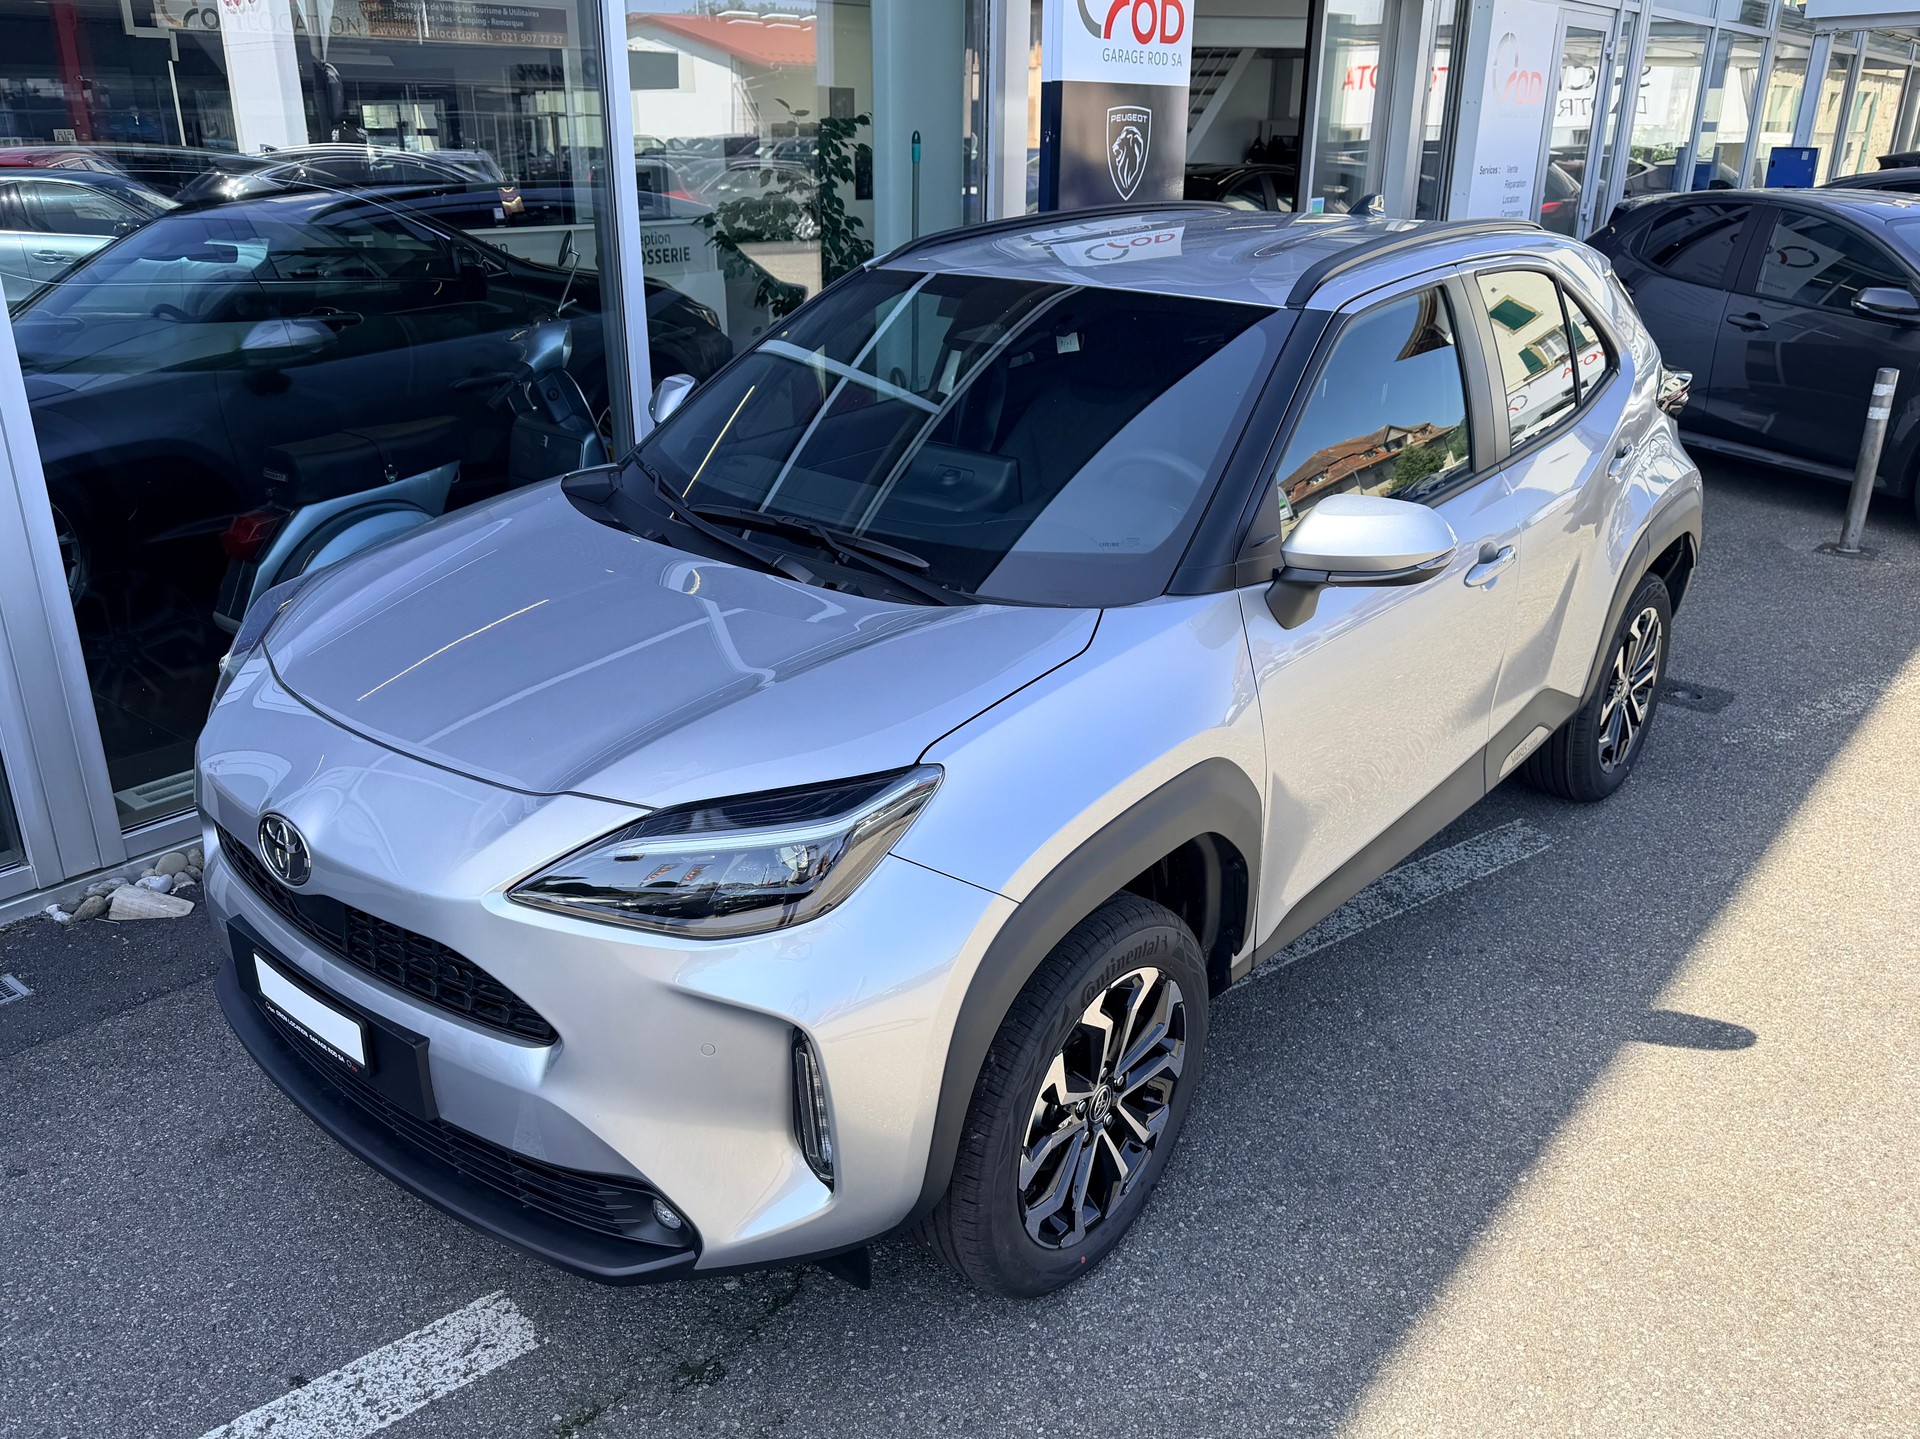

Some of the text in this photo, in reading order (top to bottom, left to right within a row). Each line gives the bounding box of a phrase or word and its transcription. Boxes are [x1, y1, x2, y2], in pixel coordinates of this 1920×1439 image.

[393, 0, 409, 8] Tous
[410, 2, 429, 11] typs
[472, 6, 502, 15] Tourisme
[508, 8, 540, 17] Utilitaires
[457, 16, 487, 26] Camping
[491, 18, 524, 28] Remorque
[376, 27, 493, 41] www.onlocation.ch
[501, 32, 518, 42] 021
[521, 33, 537, 42] 907
[540, 34, 550, 43] 77
[553, 35, 563, 44] 27
[1102, 47, 1182, 67] GARAGE ROD SA
[1110, 113, 1148, 123] PEUGEOT
[1502, 195, 1520, 204] Location
[1081, 935, 1160, 1009] Continental
